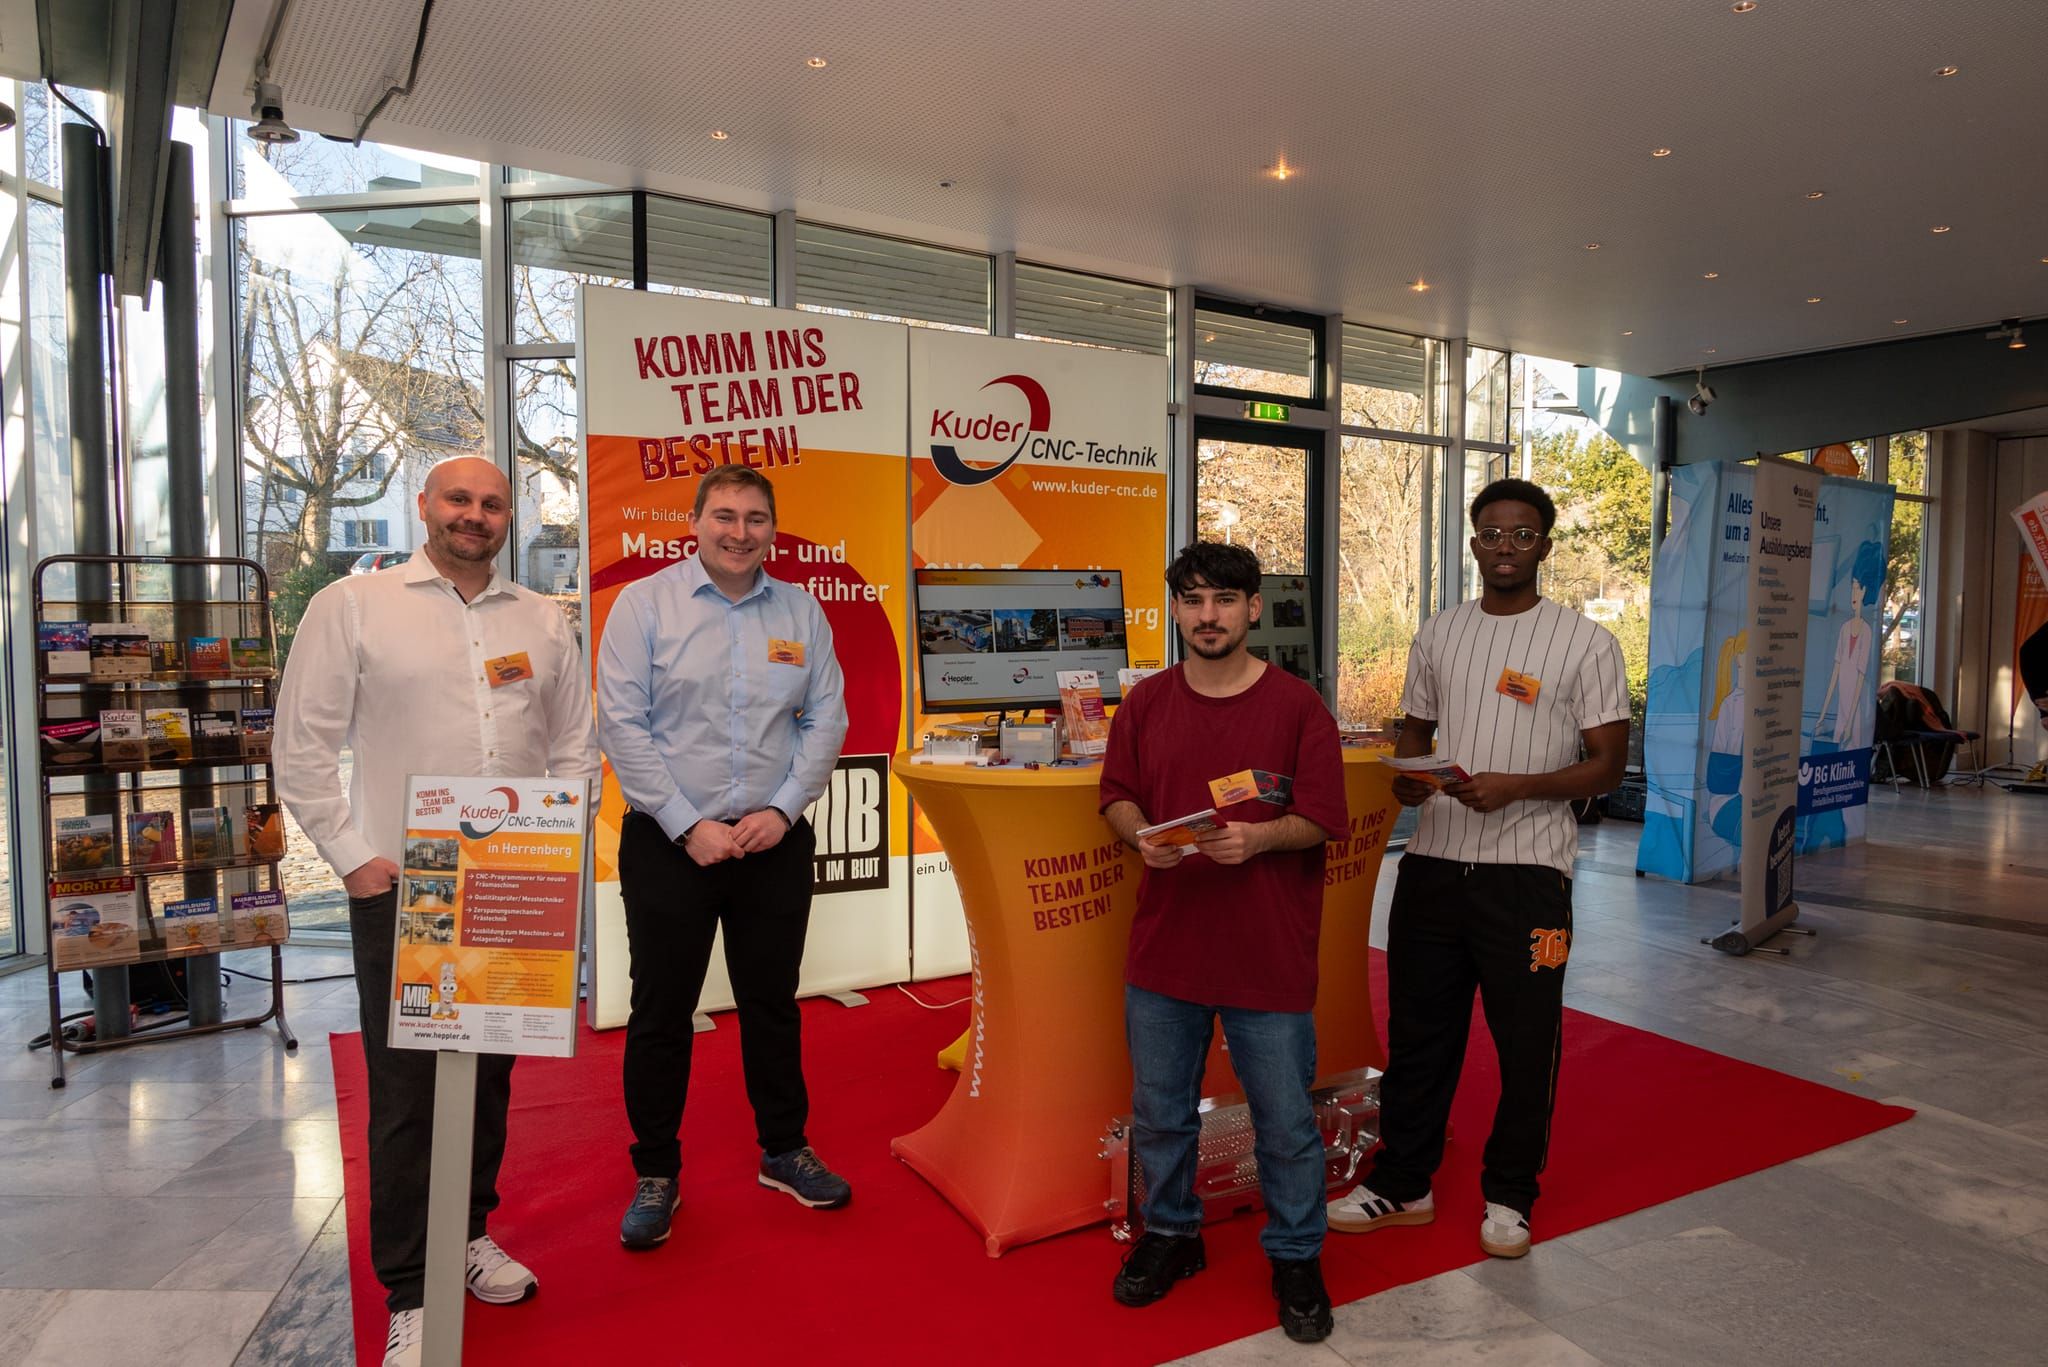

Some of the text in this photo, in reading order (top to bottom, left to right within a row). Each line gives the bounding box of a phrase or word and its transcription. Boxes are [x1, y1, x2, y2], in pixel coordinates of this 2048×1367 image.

[634, 328, 826, 379] KOMM INS
[671, 372, 863, 425] TEAM DER
[930, 409, 1024, 443] Kuder
[638, 425, 801, 481] BESTEN!
[1031, 437, 1158, 467] CNC-Technik
[1032, 479, 1158, 498] www.kuder-cnc.de
[622, 507, 648, 520] Wir
[1727, 493, 1753, 515] Alles
[1725, 525, 1741, 541] um
[798, 540, 846, 563] und
[1814, 761, 1856, 785] BG Klinik
[417, 788, 450, 799] KOMM INS
[416, 808, 443, 817] BESTEN!
[460, 805, 505, 819] Kuder
[508, 816, 575, 828] CNC-Technik
[1361, 807, 1386, 832] INS
[488, 844, 572, 857] in Herrenberg
[1326, 830, 1380, 862] AM DER
[826, 860, 844, 881] IM
[851, 857, 880, 880] BLUT
[916, 863, 935, 875] ein
[1024, 840, 1124, 879] KOMM INS
[1325, 857, 1366, 886] STEN!
[1028, 863, 1124, 905] TEAM DER
[1033, 893, 1112, 932] BESTEN!
[403, 985, 430, 1008] MIB
[400, 1022, 463, 1030] www.kuder-cnc.de
[415, 1032, 470, 1041] www.heppler.de
